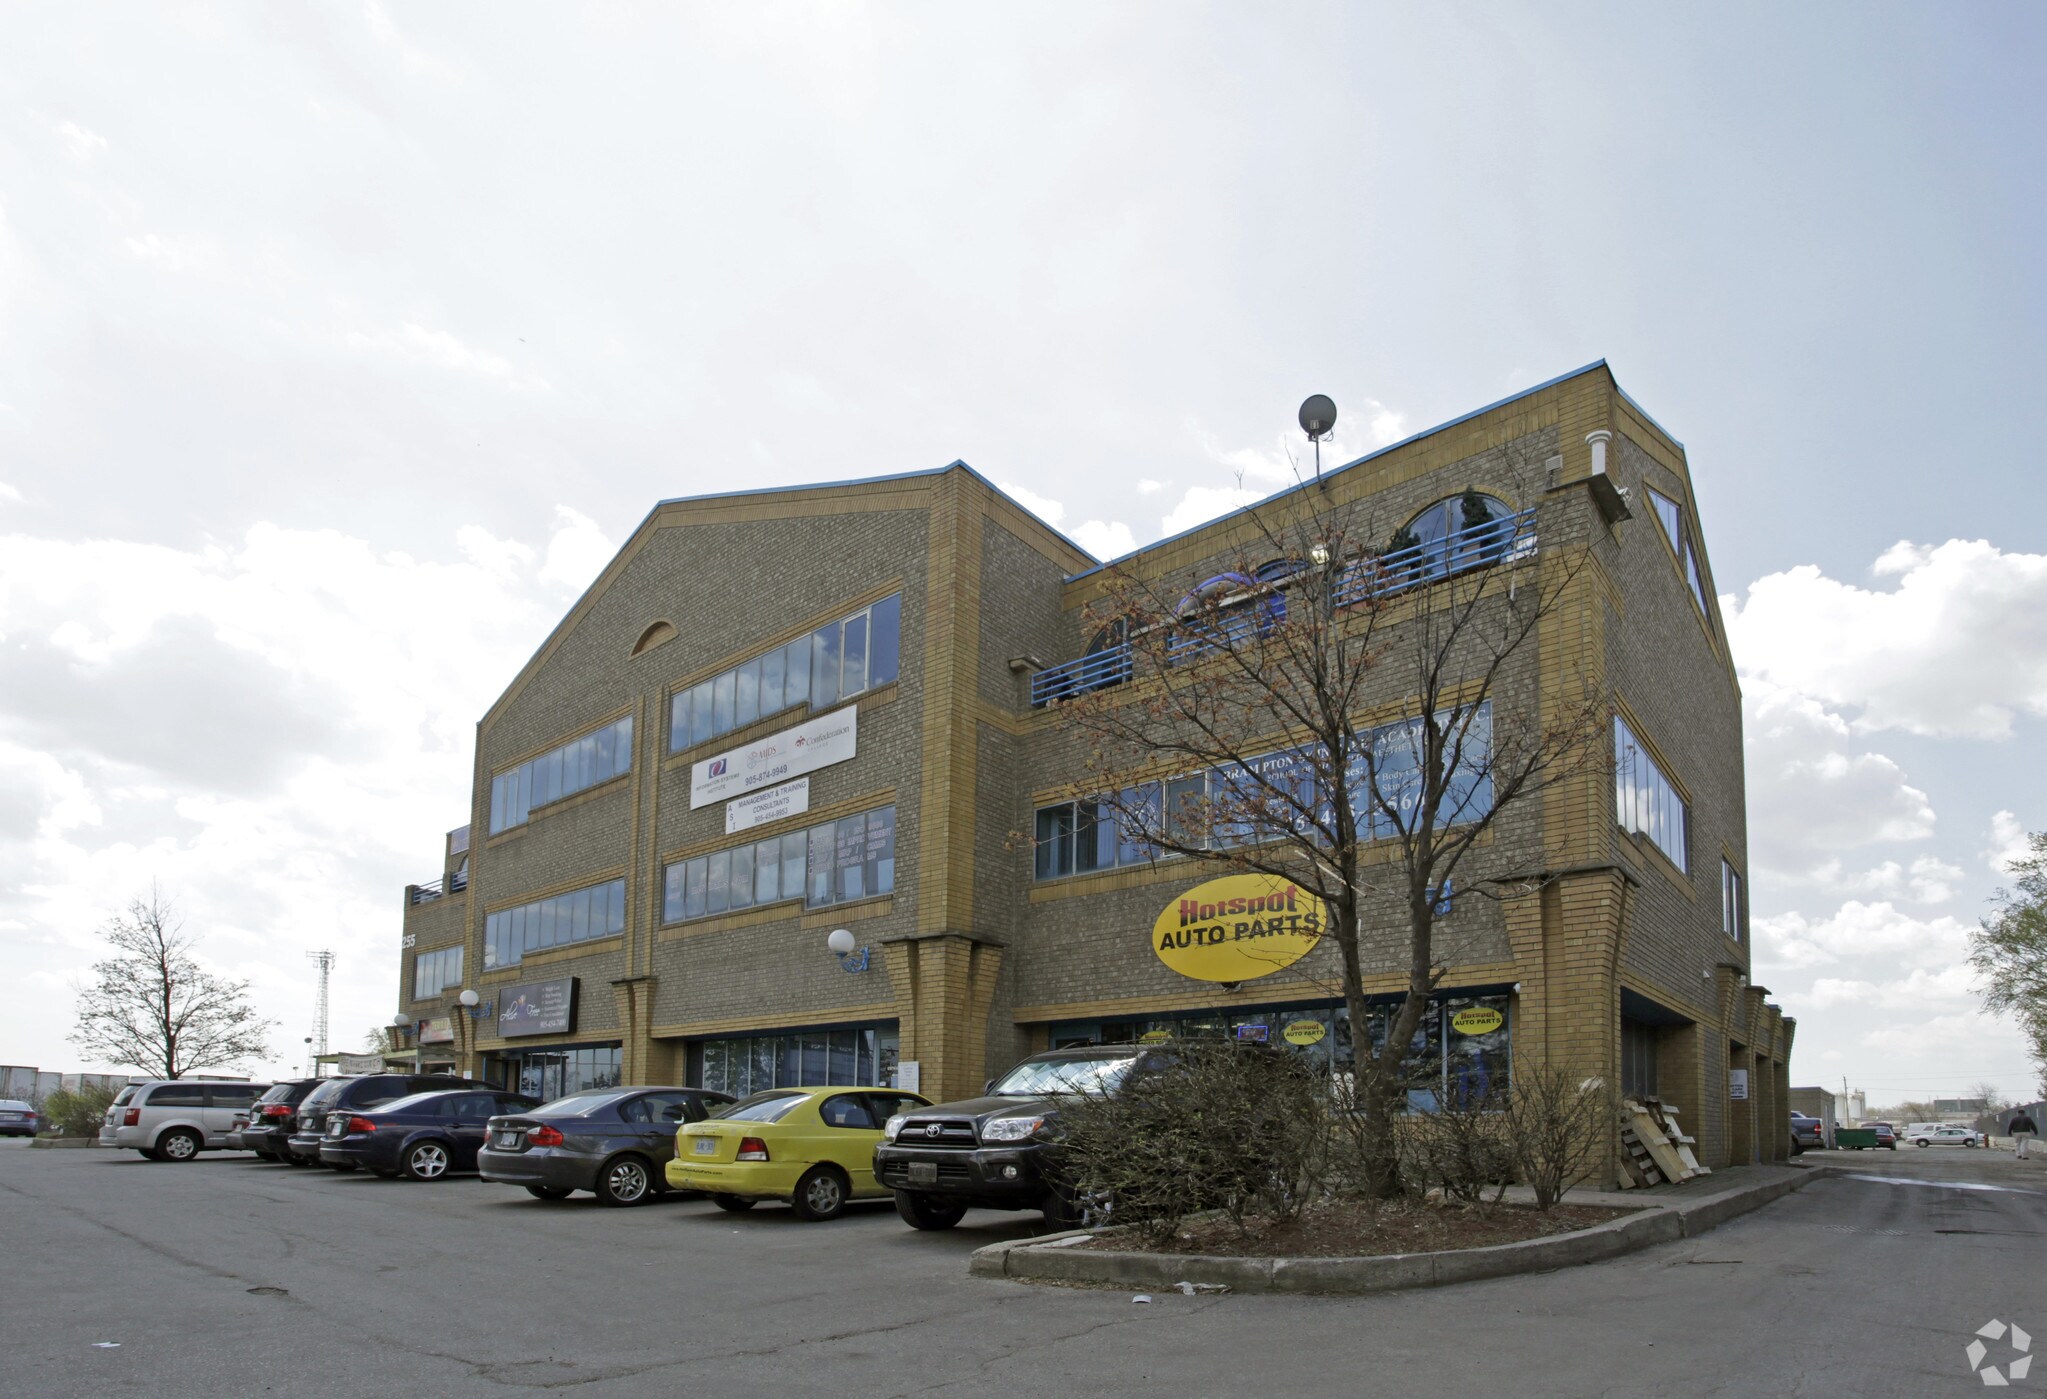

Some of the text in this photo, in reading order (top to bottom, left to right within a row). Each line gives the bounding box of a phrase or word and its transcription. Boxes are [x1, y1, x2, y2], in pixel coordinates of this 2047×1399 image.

[807, 726, 850, 746] Confederation
[745, 764, 788, 787] 905-874-9949
[1382, 770, 1403, 781] Body
[738, 791, 774, 809] MANAGEMENT
[780, 780, 807, 795] TRAINING
[752, 796, 790, 814] CONSULTANTS
[1160, 912, 1320, 951] AUTO PARTS
